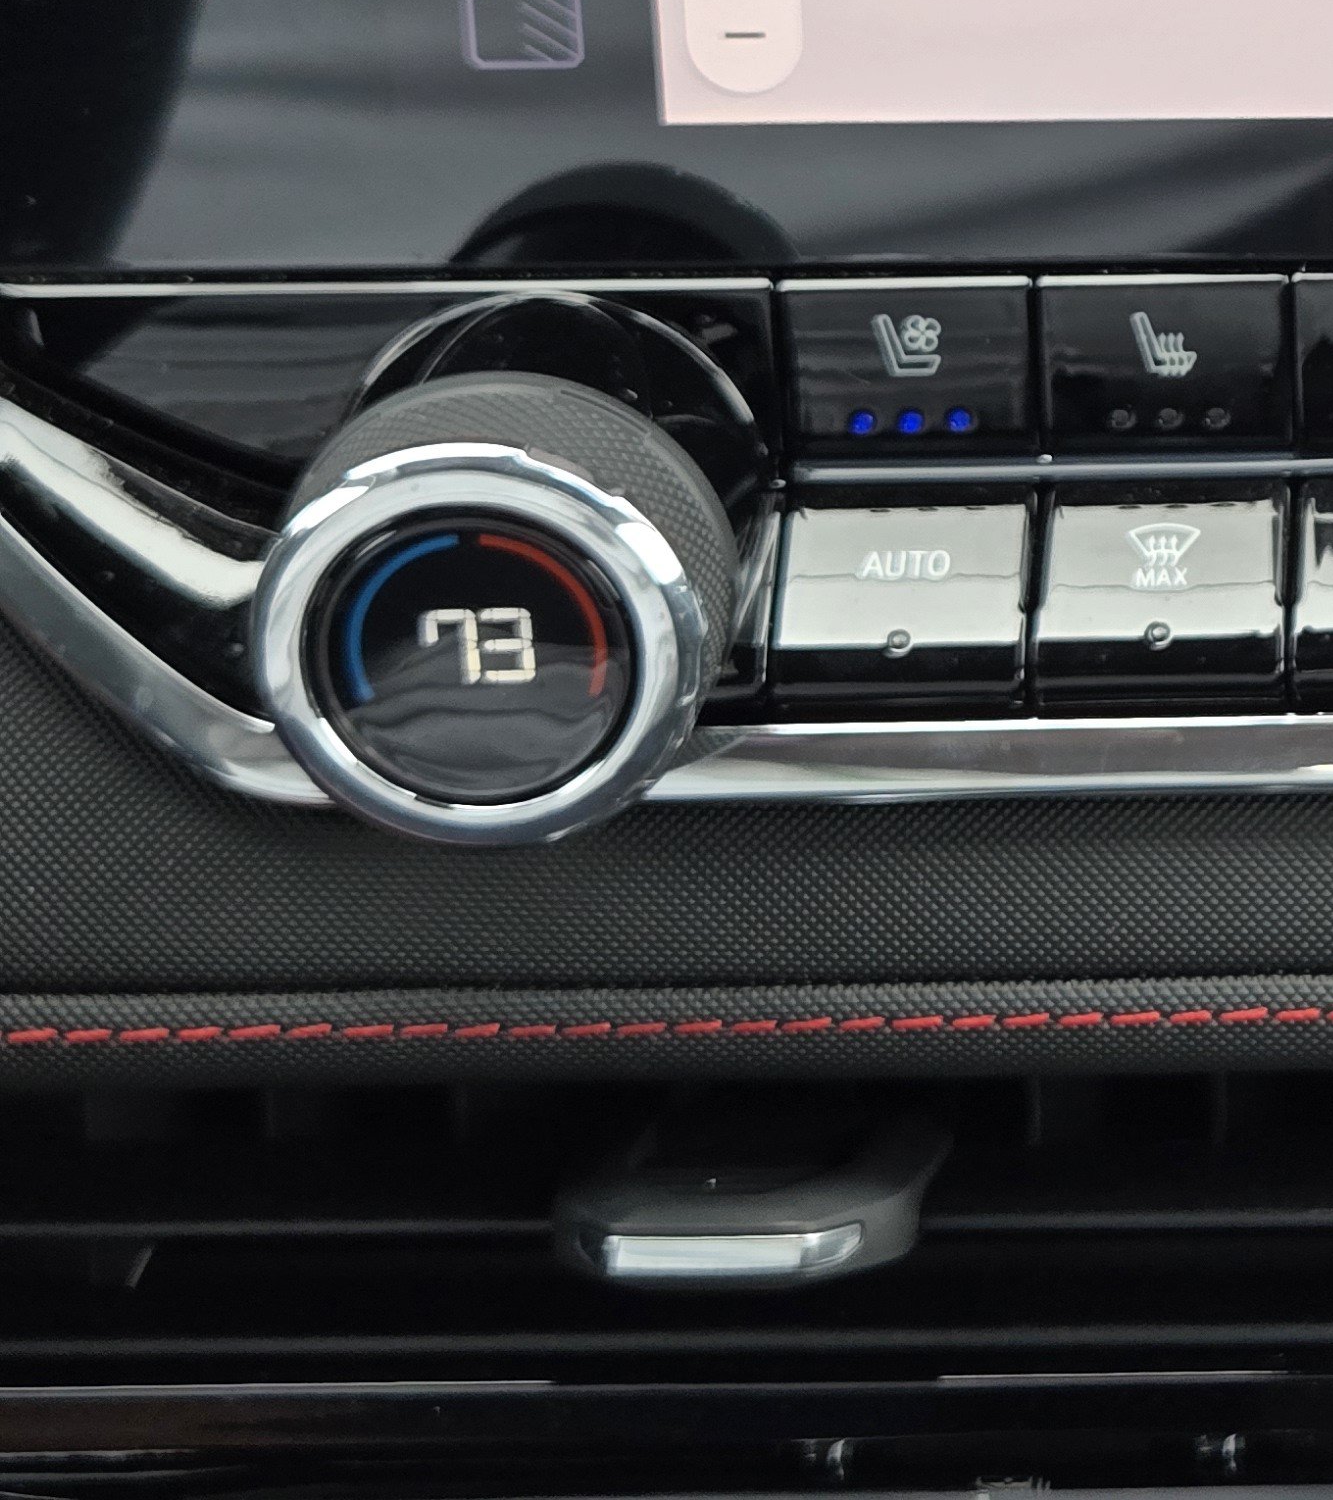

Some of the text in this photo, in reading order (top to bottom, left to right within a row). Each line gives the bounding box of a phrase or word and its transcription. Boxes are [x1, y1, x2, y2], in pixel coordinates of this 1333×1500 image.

[861, 549, 952, 579] AUTO
[1135, 567, 1189, 587] MAX
[418, 606, 538, 685] 73
